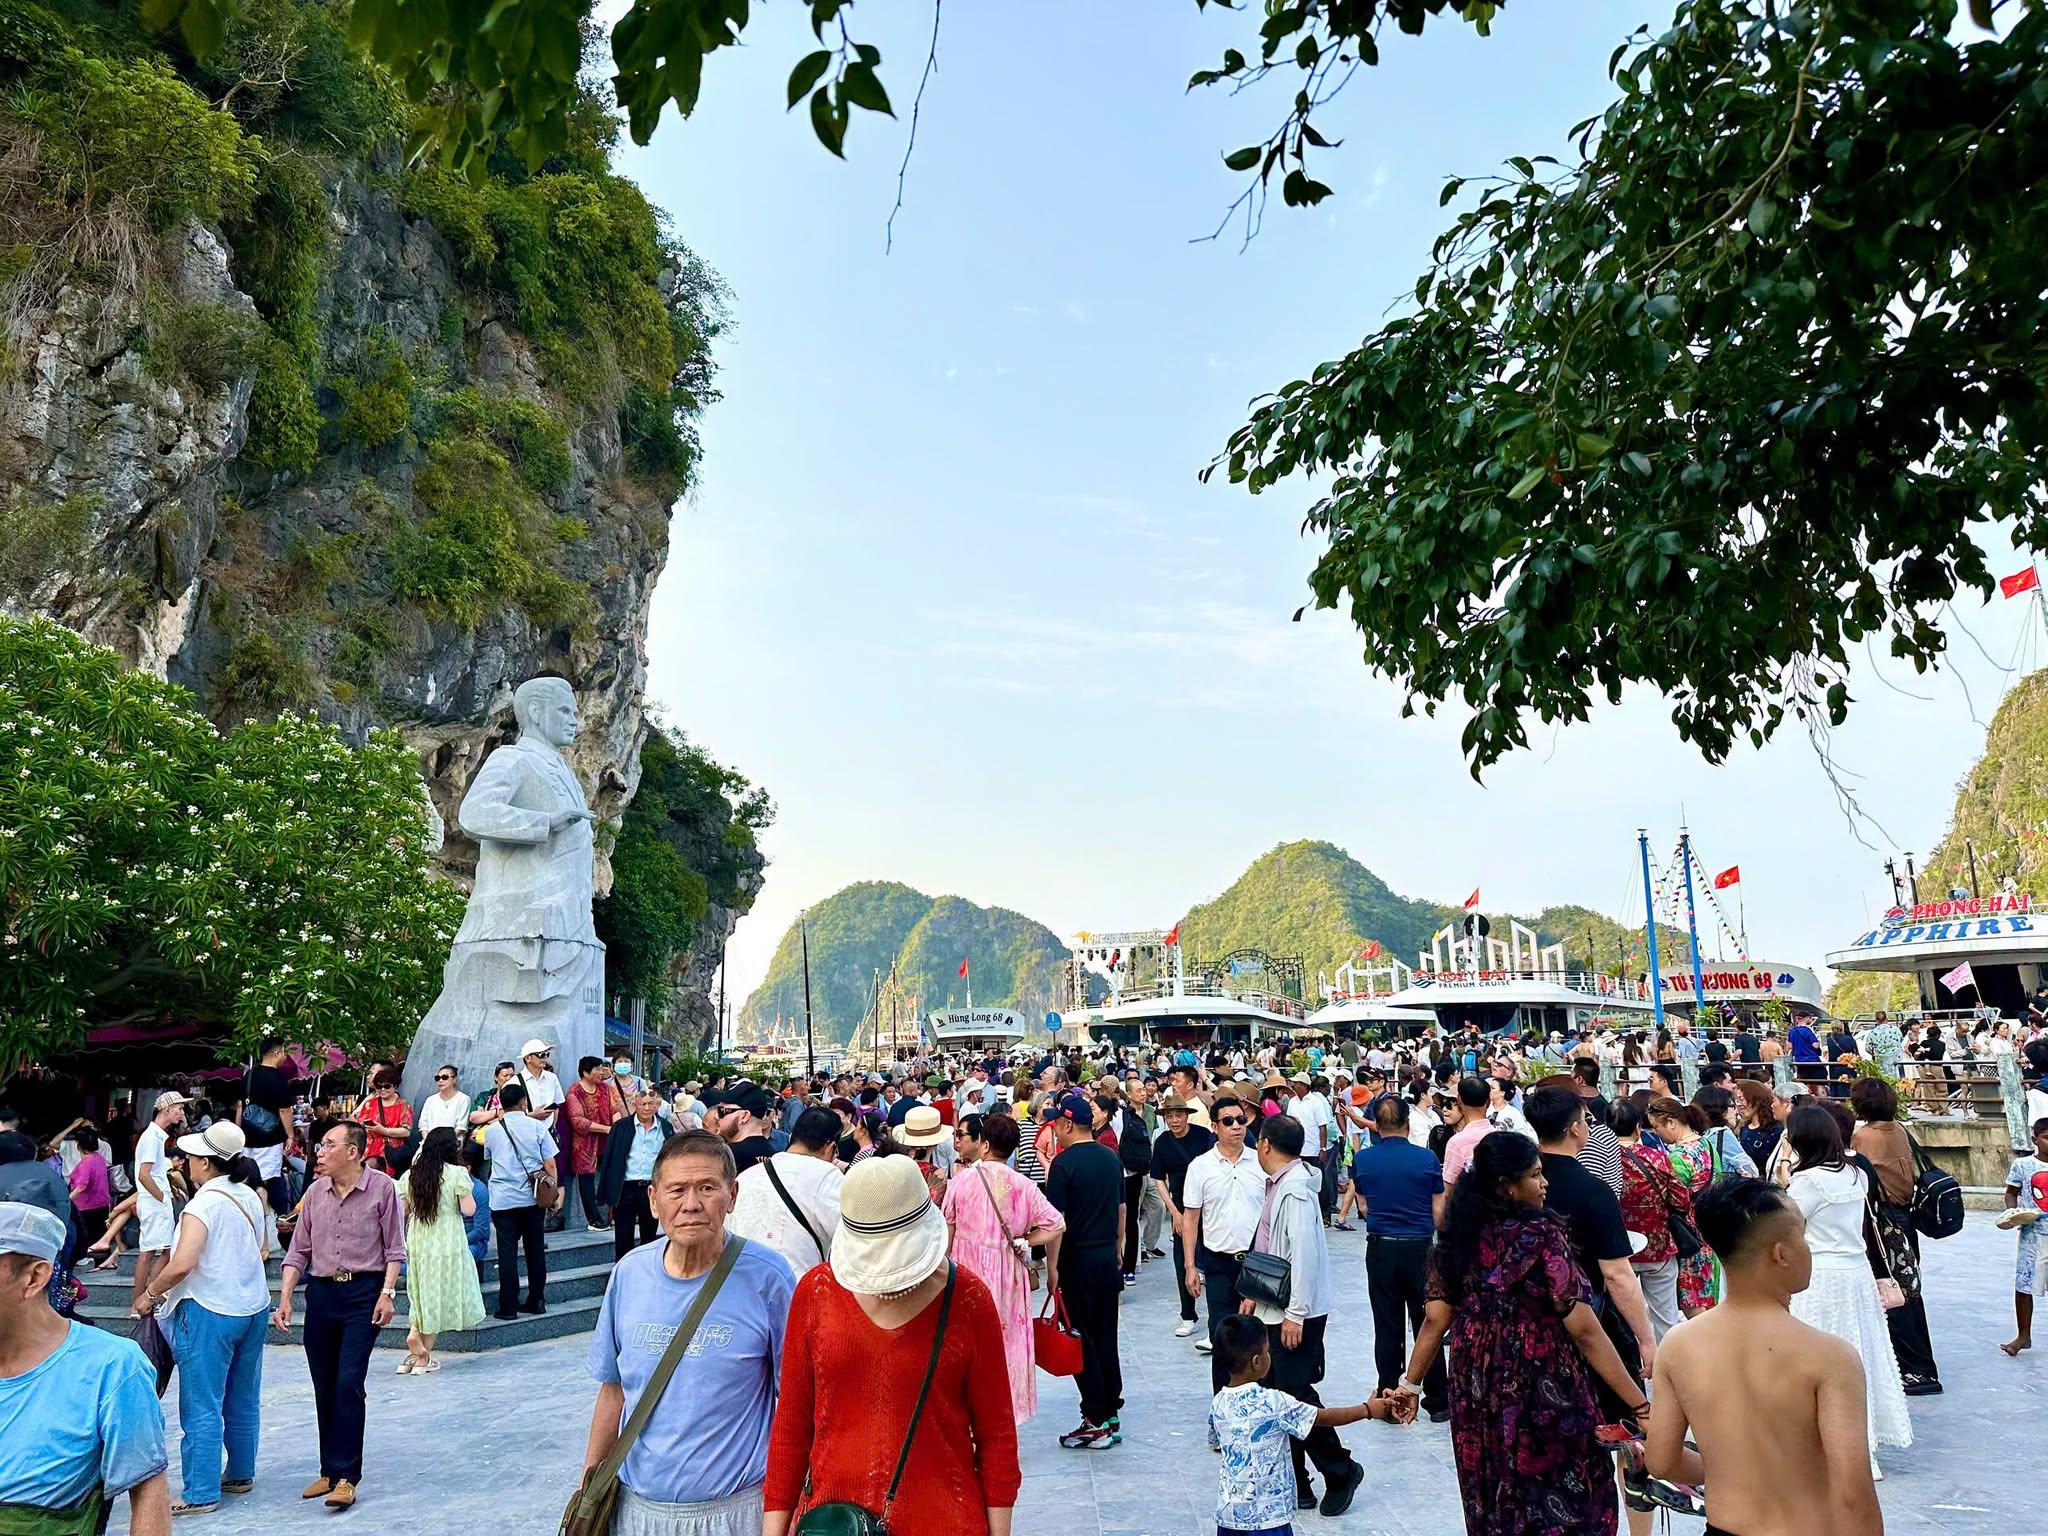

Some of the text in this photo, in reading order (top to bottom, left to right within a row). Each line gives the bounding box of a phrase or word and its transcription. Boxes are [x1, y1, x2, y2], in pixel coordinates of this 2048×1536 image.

[1912, 897, 1982, 919] PHONG
[1478, 980, 1511, 988] CRUISE
[1753, 972, 1773, 989] 68
[948, 1012, 1004, 1024] Hùng Long 68
